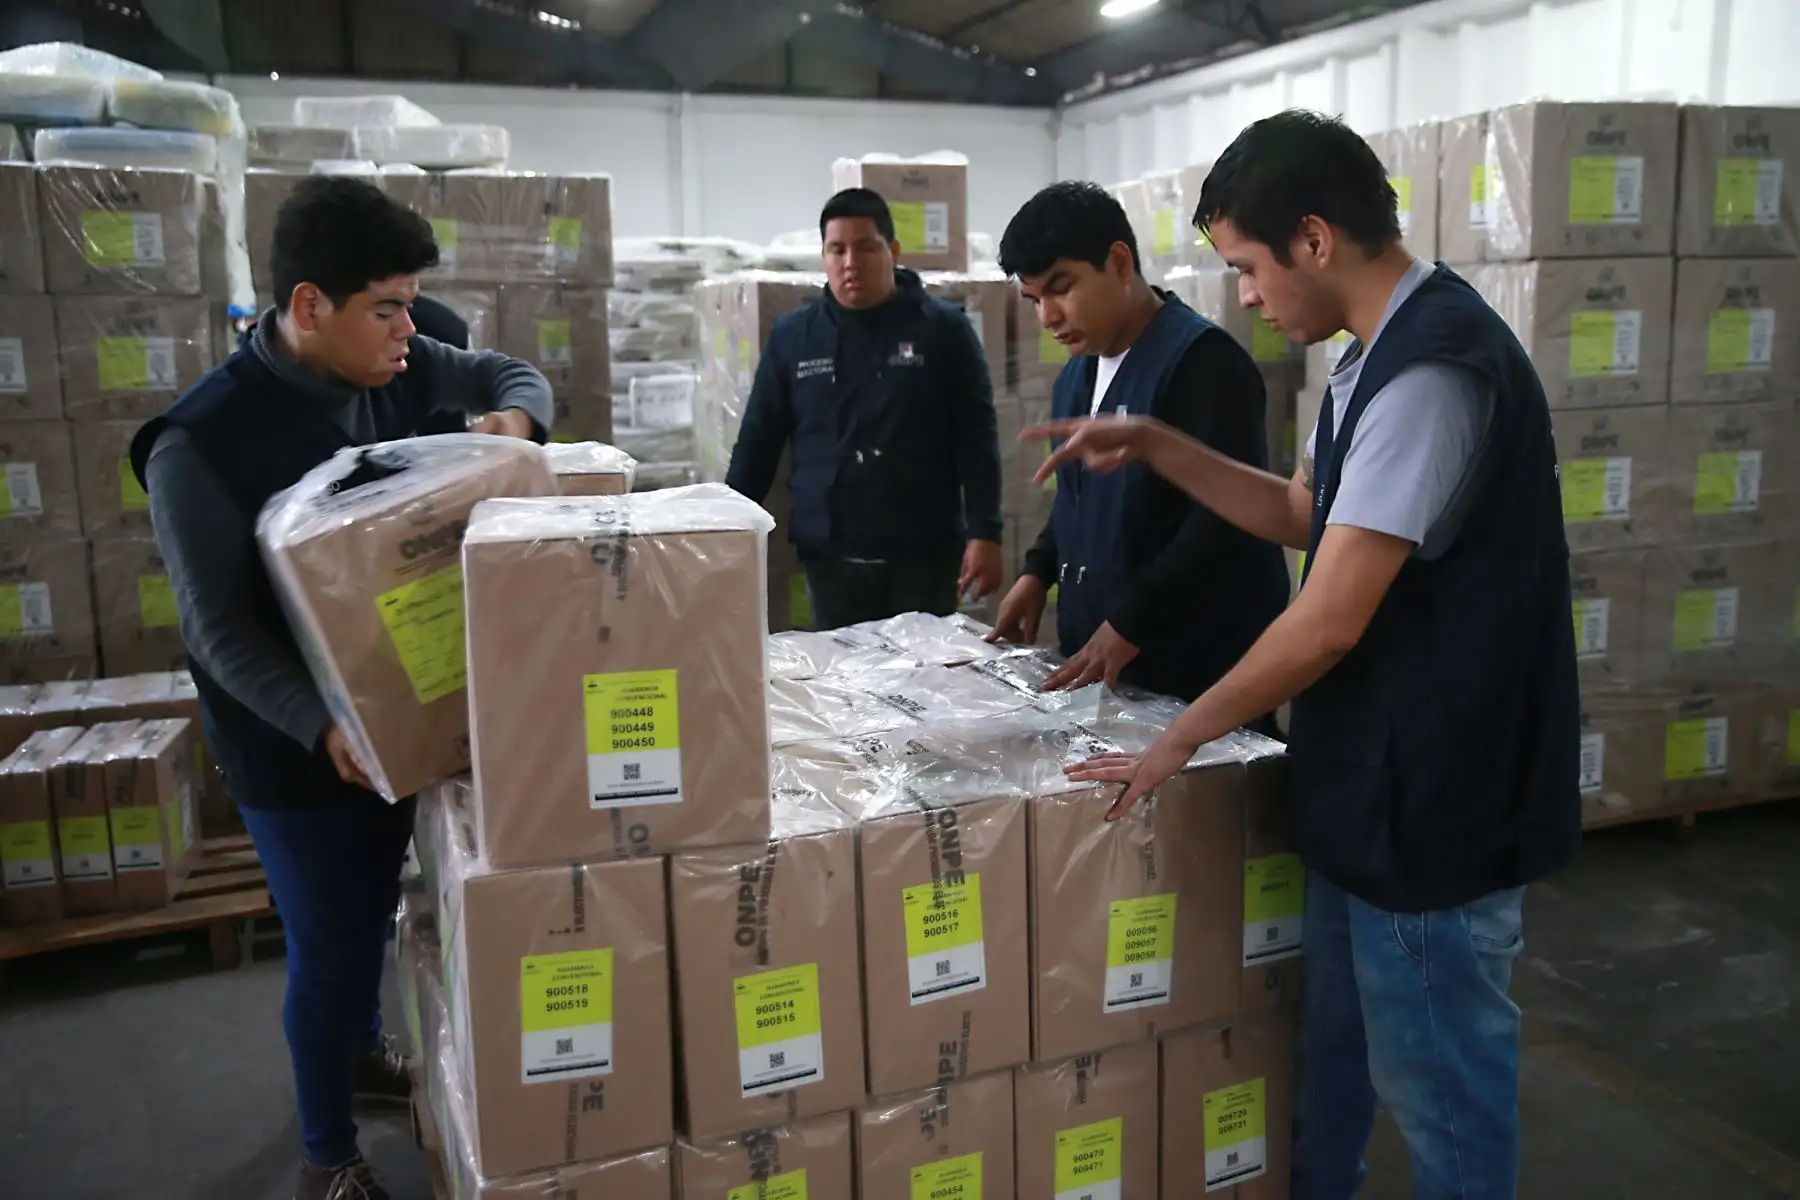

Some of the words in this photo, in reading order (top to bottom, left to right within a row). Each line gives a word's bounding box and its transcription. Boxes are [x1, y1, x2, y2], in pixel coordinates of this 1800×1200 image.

[610, 706, 654, 719] 900448
[611, 722, 655, 735] 900449
[612, 737, 655, 749] 900450
[938, 808, 966, 889] ONPE
[735, 863, 760, 947] ONPE
[922, 909, 959, 925] 900516
[924, 922, 960, 938] 900517
[545, 983, 588, 997] 900518
[545, 998, 589, 1012] 900519
[755, 1000, 794, 1015] 900514
[756, 1012, 796, 1028] 900515
[1072, 1148, 1105, 1163] 900470
[1072, 1160, 1104, 1175] 900471
